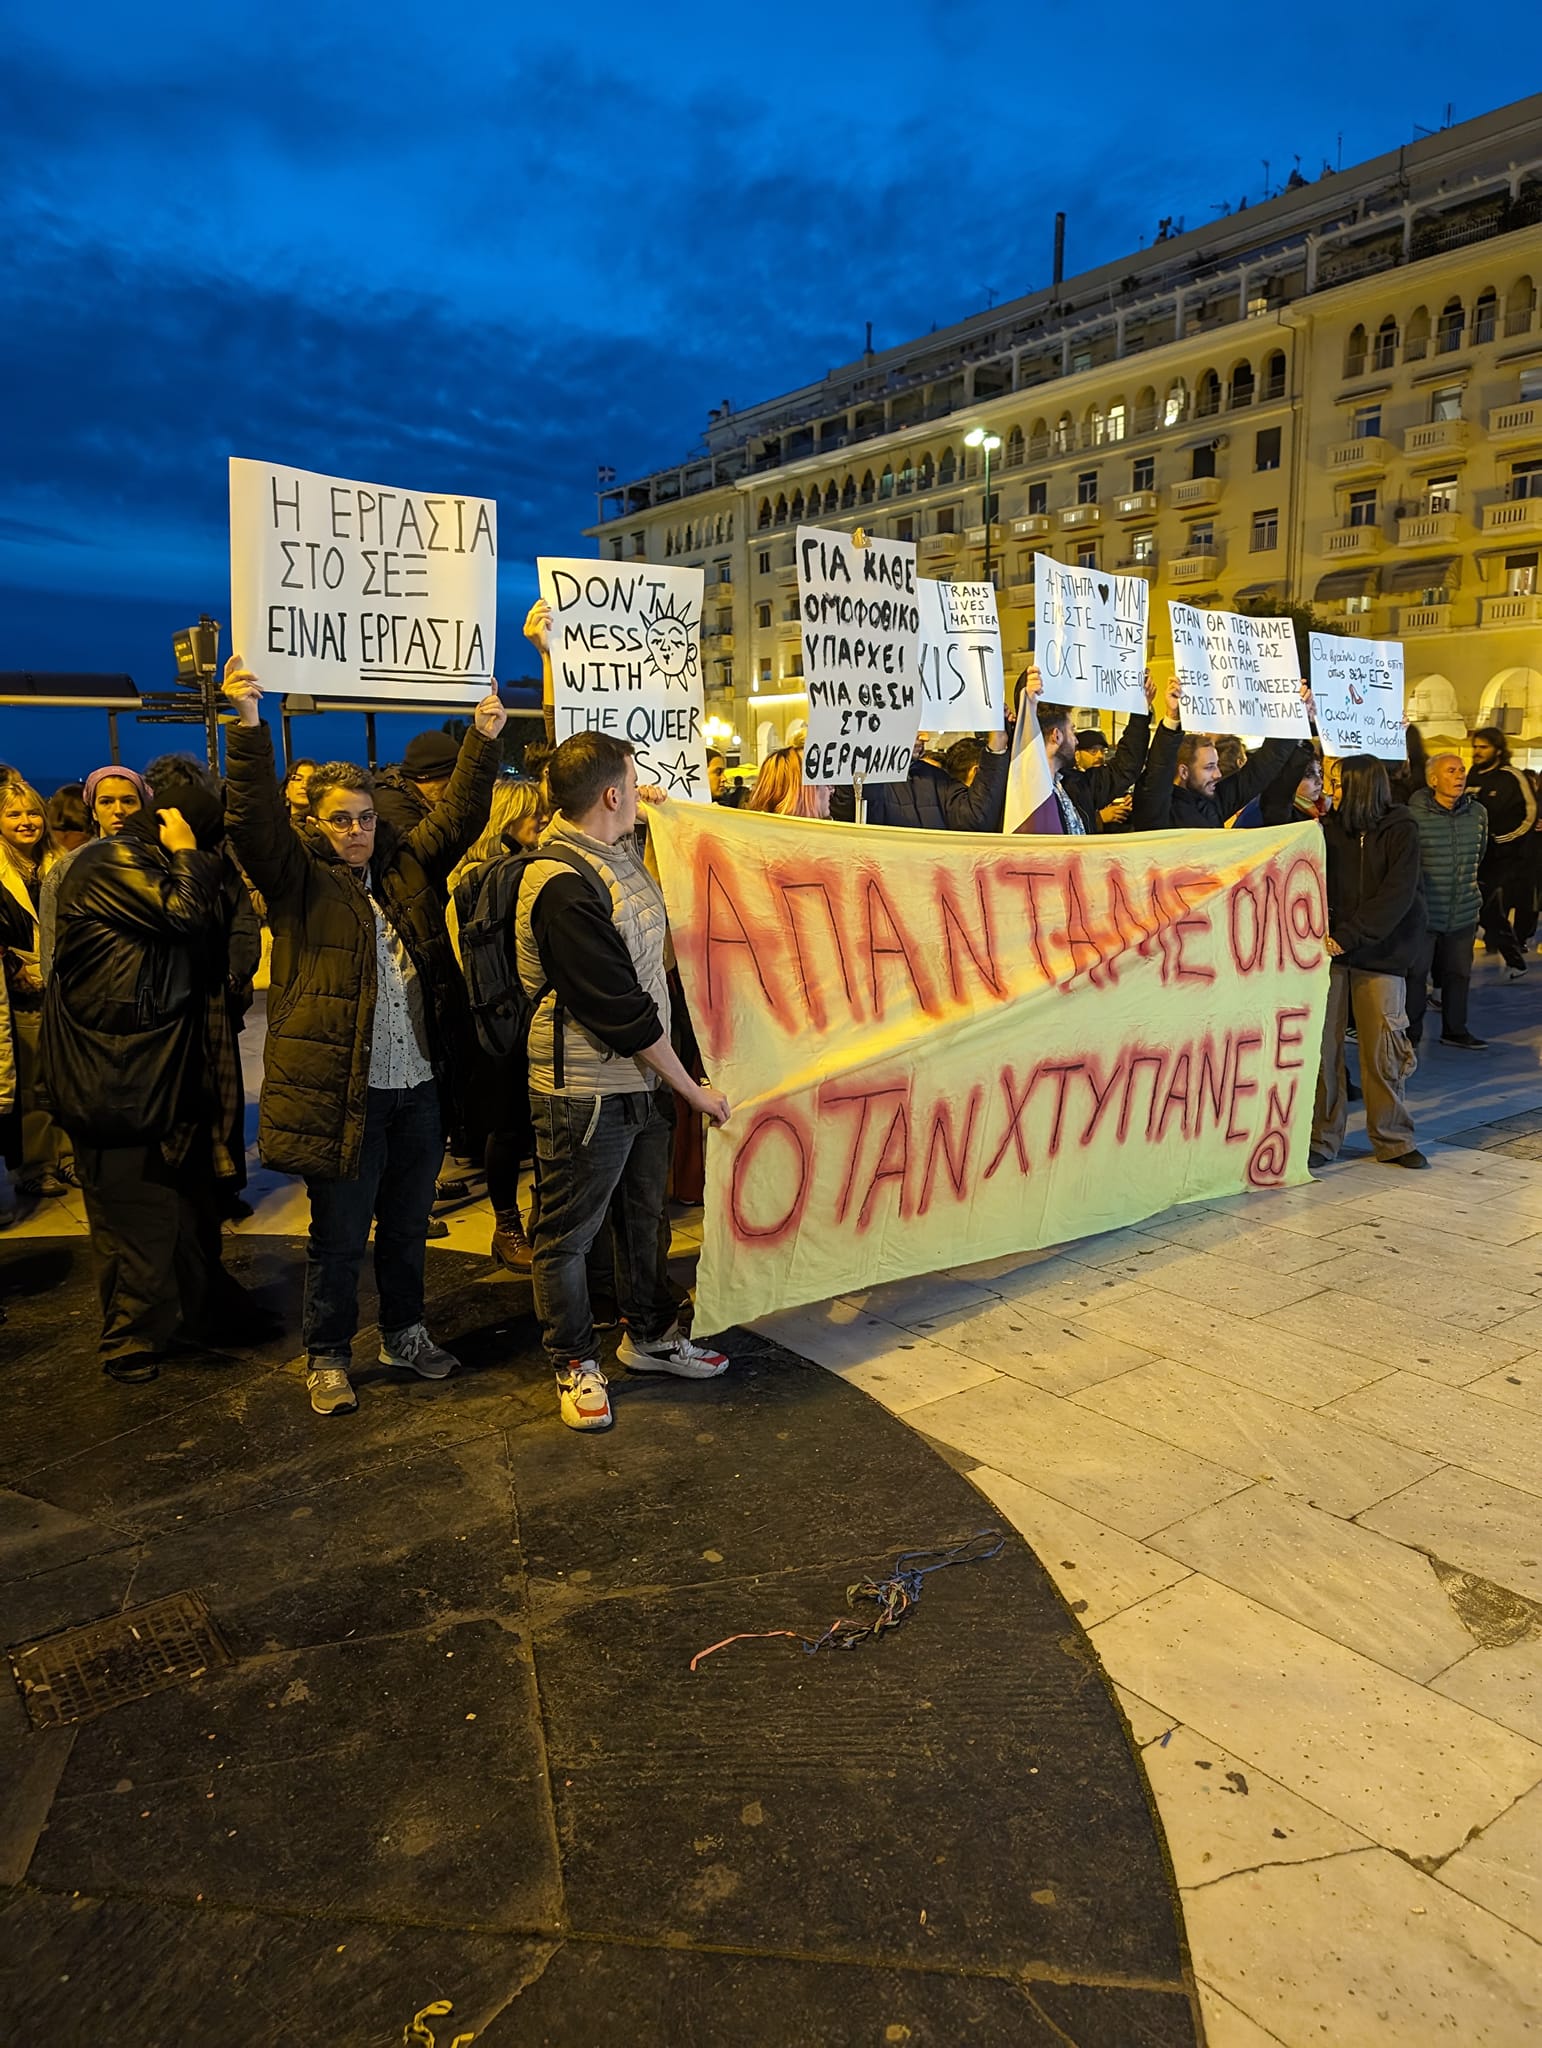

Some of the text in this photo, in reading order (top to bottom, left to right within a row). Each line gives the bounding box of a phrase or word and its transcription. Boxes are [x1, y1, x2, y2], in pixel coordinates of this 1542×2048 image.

[272, 477, 495, 556] Η ΕΡΓΑΣΙΑ
[281, 541, 429, 597] ΣΤΟ ΣΕΞ
[802, 539, 915, 595] ΓΙΑ ΚΑΘΕ
[552, 571, 666, 613] DON'T
[941, 584, 989, 598] TRANS
[948, 600, 985, 611] LIVES
[950, 613, 998, 626] MATTER
[1100, 623, 1144, 646] ΤΡΑΝΣ
[1173, 607, 1291, 640] ΟΤΑΝ ΘΑ ΠΕΡΝΑΜΕ
[268, 605, 486, 672] ΕΙΝΑΙ ΕΡΓΑΣΙΑ
[564, 622, 643, 652] MESS
[1174, 629, 1283, 658] ΣΤΑ ΜΑΤΙΑ ΘΑ ΣΑΣ
[1312, 638, 1328, 661] Θα
[805, 634, 904, 674] ΥΠΑΡΧΕΙ
[1046, 639, 1088, 680] ΟΧΙ
[1209, 654, 1260, 673] ΚΟΙΤΑΜΕ
[562, 661, 642, 692] WITH
[918, 642, 994, 709] XIST
[1222, 675, 1240, 690] ΟΤΙ
[1244, 677, 1301, 694] ΠΟΝΕΣΕΣ
[809, 680, 914, 710] ΜΙΑ ΘΕΣΗ
[1180, 694, 1237, 716] ΦΑΣΙΣΤΑ
[1239, 698, 1255, 716] ΜΟΥ
[561, 706, 703, 747] THE QUEER
[841, 710, 881, 736] ΣΤΟ
[1337, 729, 1362, 744] ΚΑΘΕ
[805, 742, 910, 780] ΘΕΡΜΑΙΚΟ
[682, 842, 1224, 1050] ΑΠΑΝΤΑΜΕ
[729, 1033, 1262, 1243] ΟΤΑΝ ΧΤΥΠΑΝΕ
